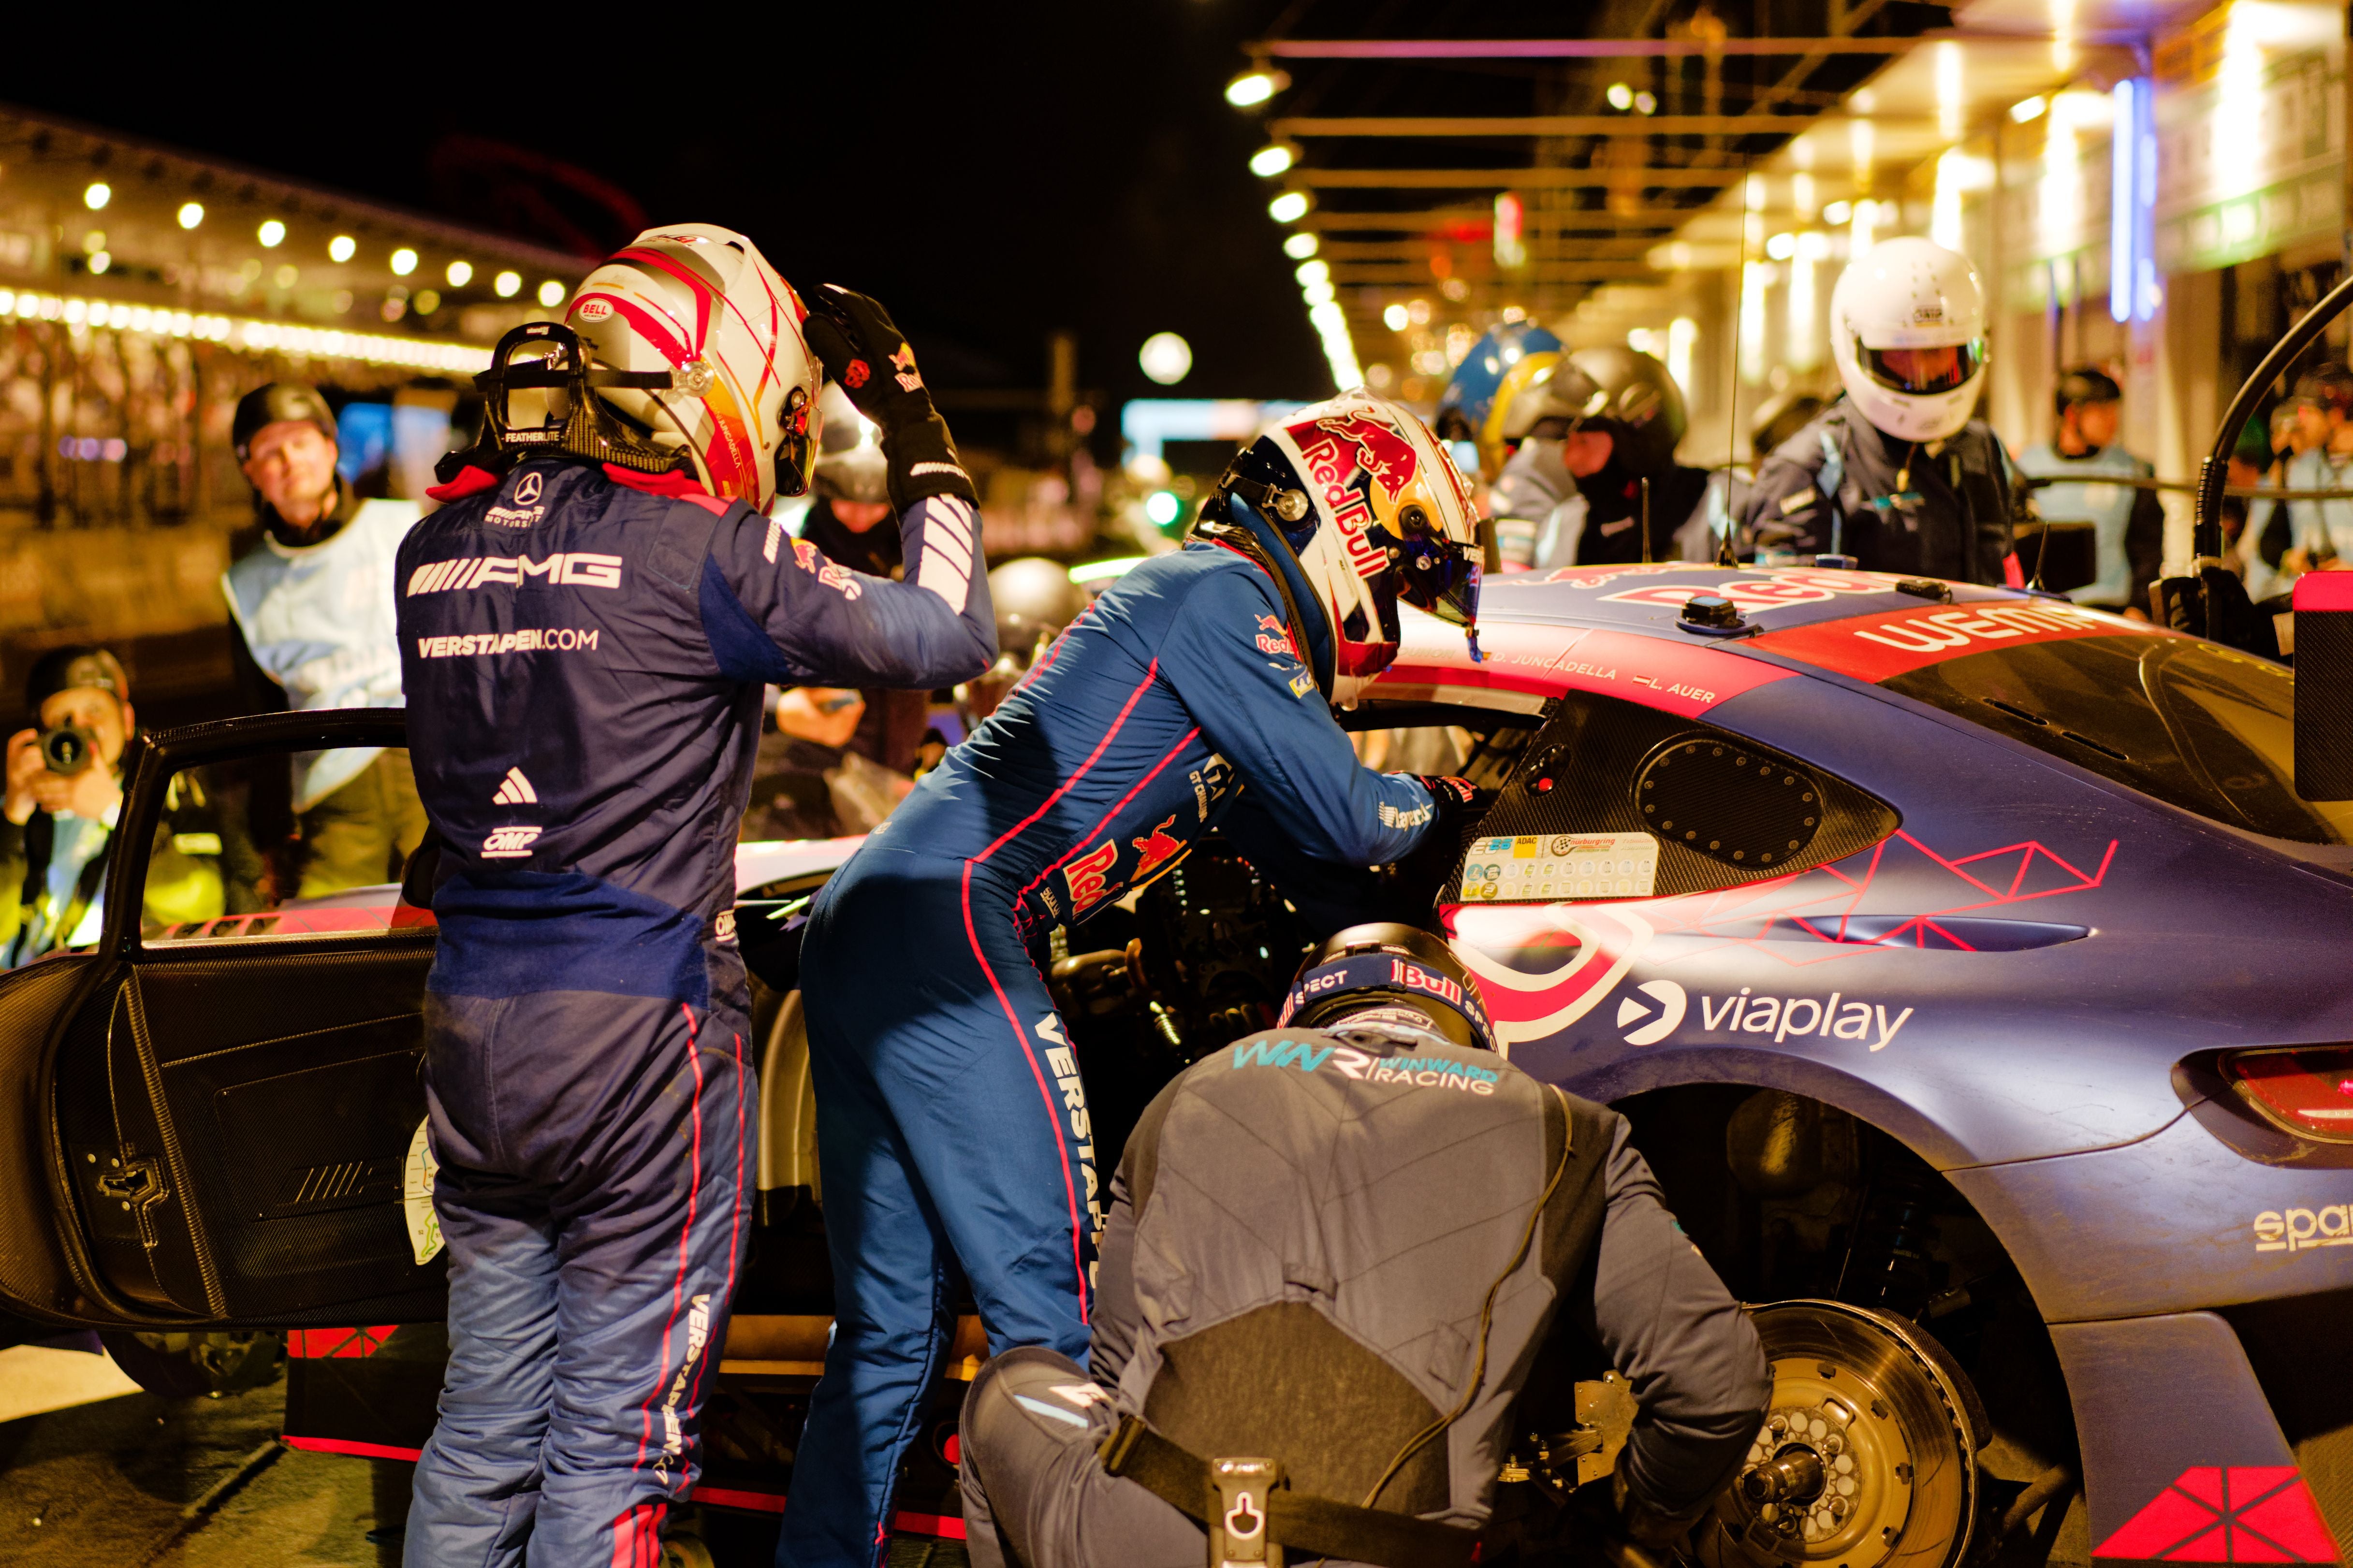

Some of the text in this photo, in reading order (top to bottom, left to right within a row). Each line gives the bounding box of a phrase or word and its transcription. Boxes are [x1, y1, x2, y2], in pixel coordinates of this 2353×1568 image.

[583, 304, 607, 315] BELL
[505, 432, 560, 442] FEATHERLITE
[465, 552, 623, 589] AMG
[1492, 653, 1506, 663] D.
[1511, 654, 1617, 680] JUNCADELLA
[1649, 678, 1715, 703] L. AUER
[483, 832, 539, 851] OMP
[1570, 838, 1616, 846] nürburgring
[1701, 987, 1914, 1052] viaplay
[1374, 1070, 1495, 1096] RACING
[1379, 1057, 1498, 1083] WINWARD
[2254, 1204, 2353, 1252] spa
